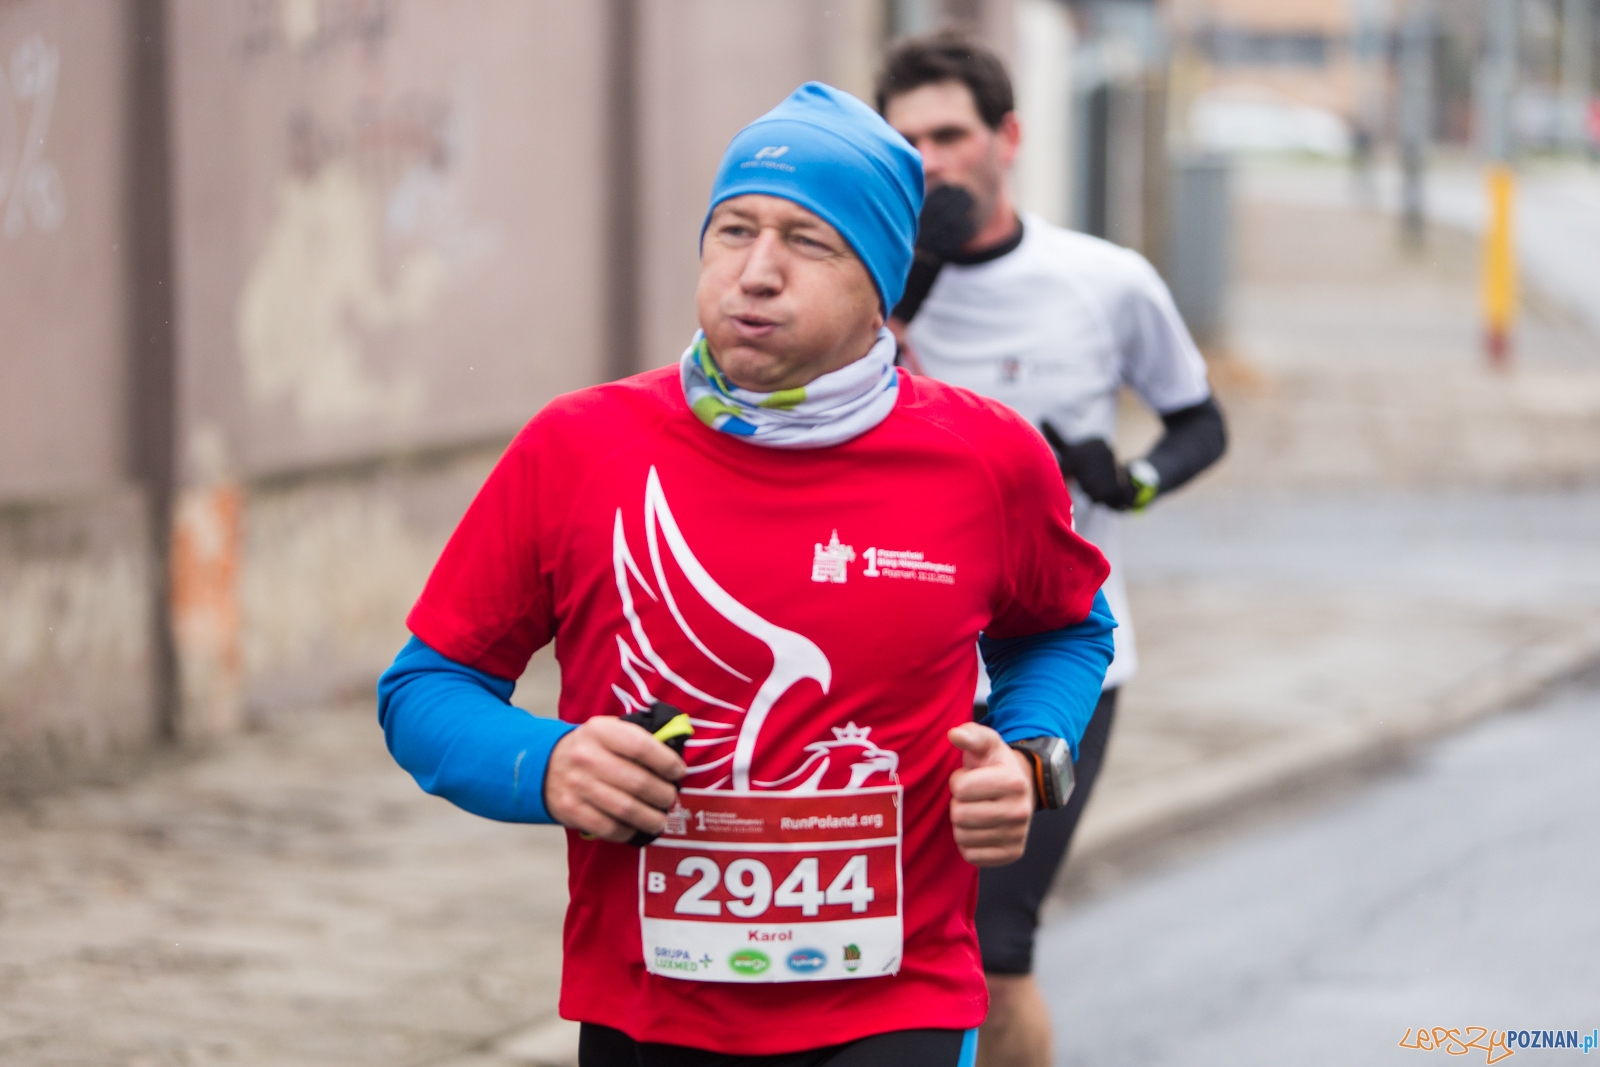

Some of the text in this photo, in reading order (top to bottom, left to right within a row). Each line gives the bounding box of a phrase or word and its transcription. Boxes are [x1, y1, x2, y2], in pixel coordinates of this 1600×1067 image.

[862, 547, 880, 577] 1
[781, 813, 884, 830] RunPoland.org
[647, 854, 875, 918] B 2944
[748, 929, 793, 942] Karol
[654, 946, 691, 960] GRUPA
[654, 957, 698, 972] LUXMED
